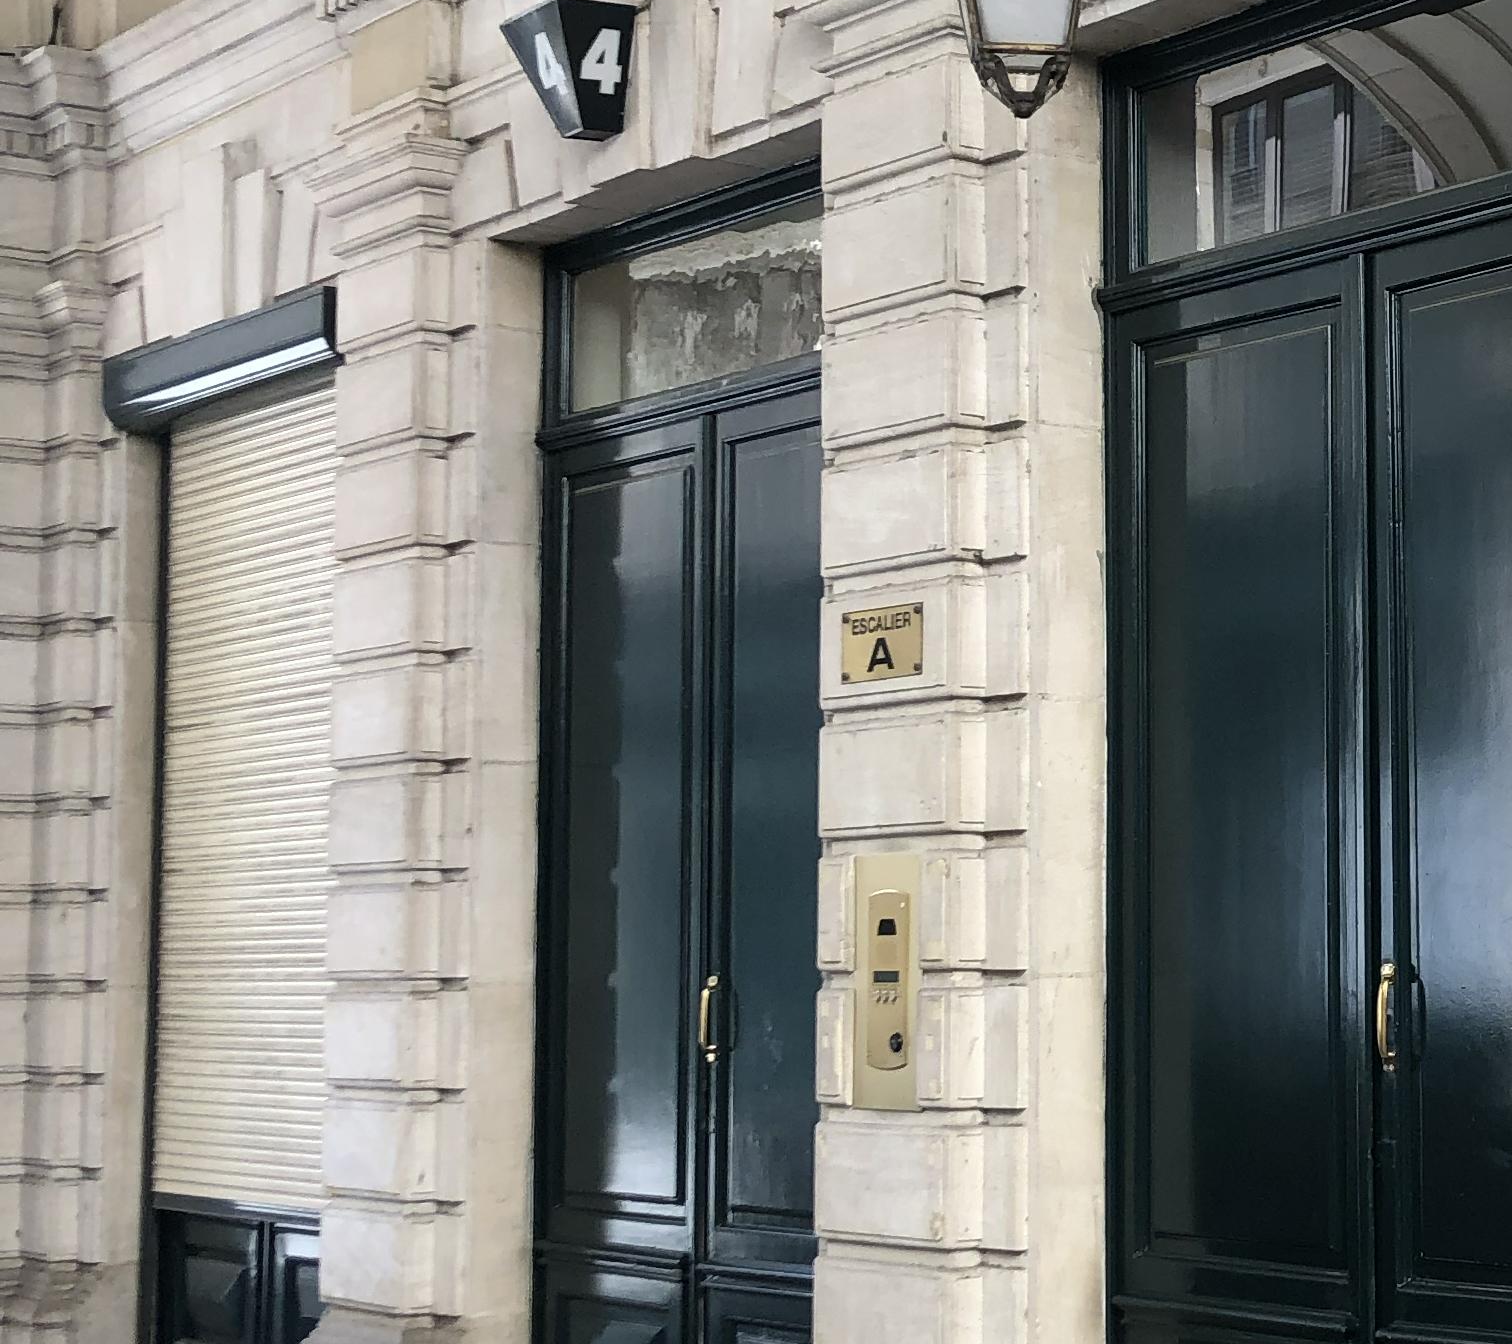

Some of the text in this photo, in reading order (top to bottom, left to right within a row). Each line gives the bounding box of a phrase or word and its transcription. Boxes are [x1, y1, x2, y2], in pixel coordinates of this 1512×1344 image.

[535, 32, 567, 94] 4
[580, 28, 622, 94] 4
[852, 612, 911, 635] ESCALIER
[867, 637, 895, 672] A
